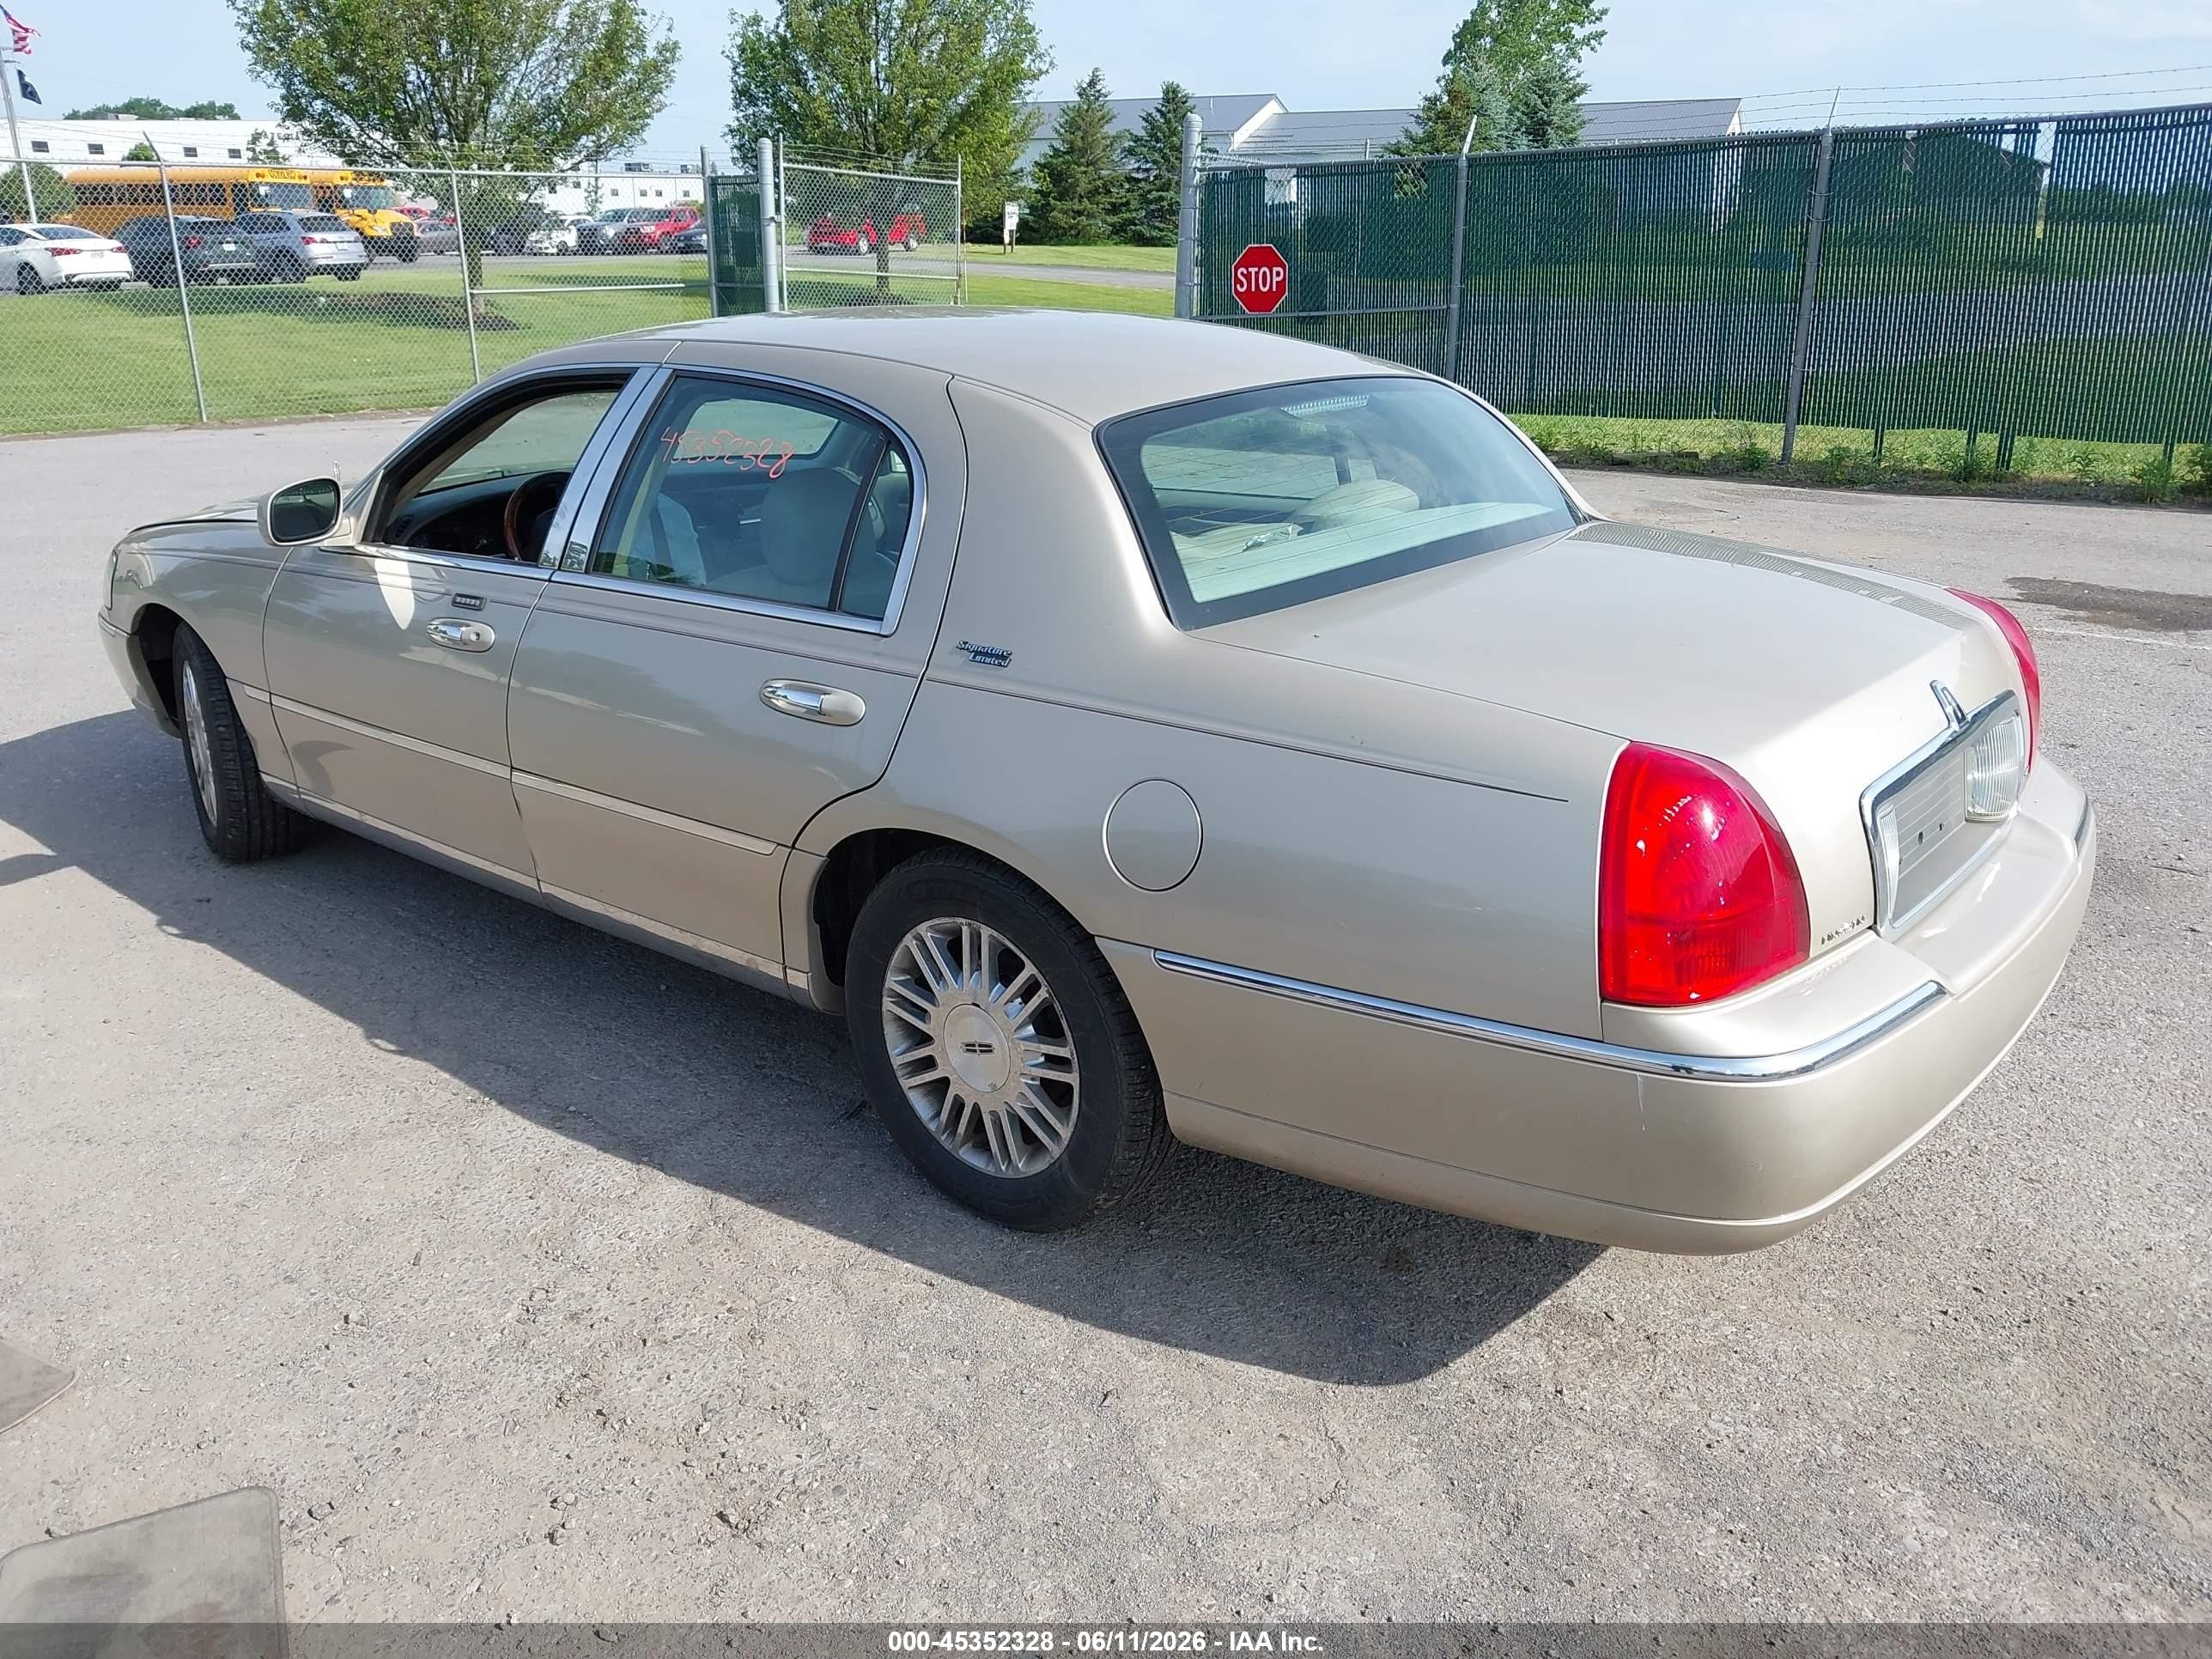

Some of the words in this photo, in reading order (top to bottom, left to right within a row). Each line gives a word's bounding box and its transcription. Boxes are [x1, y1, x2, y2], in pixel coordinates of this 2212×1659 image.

[1237, 266, 1285, 292] STOP
[957, 640, 1012, 657] Signature
[969, 653, 1012, 668] Limited
